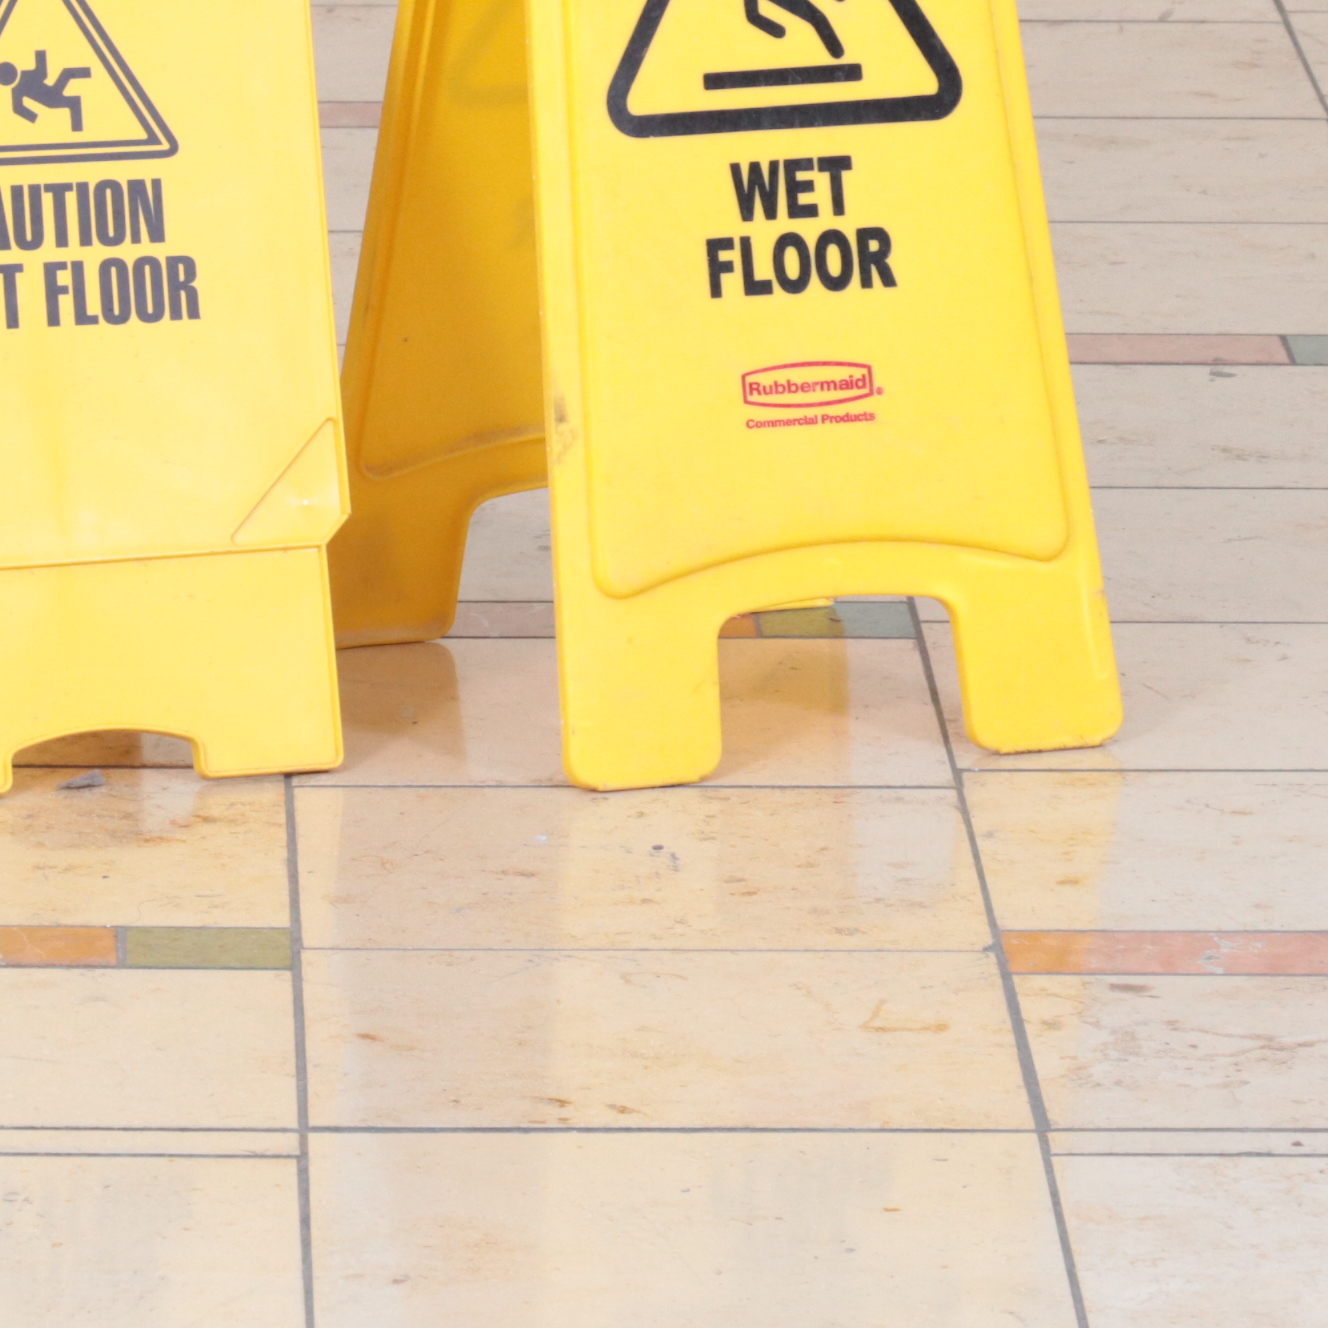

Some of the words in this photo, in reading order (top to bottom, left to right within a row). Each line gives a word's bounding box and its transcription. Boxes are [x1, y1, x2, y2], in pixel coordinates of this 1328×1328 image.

[729, 155, 853, 222] WET
[43, 255, 201, 327] FLOOR
[705, 226, 898, 299] FLOOR
[748, 374, 867, 397] Rubbermaid
[746, 415, 818, 429] Commercial
[821, 412, 876, 424] Products
